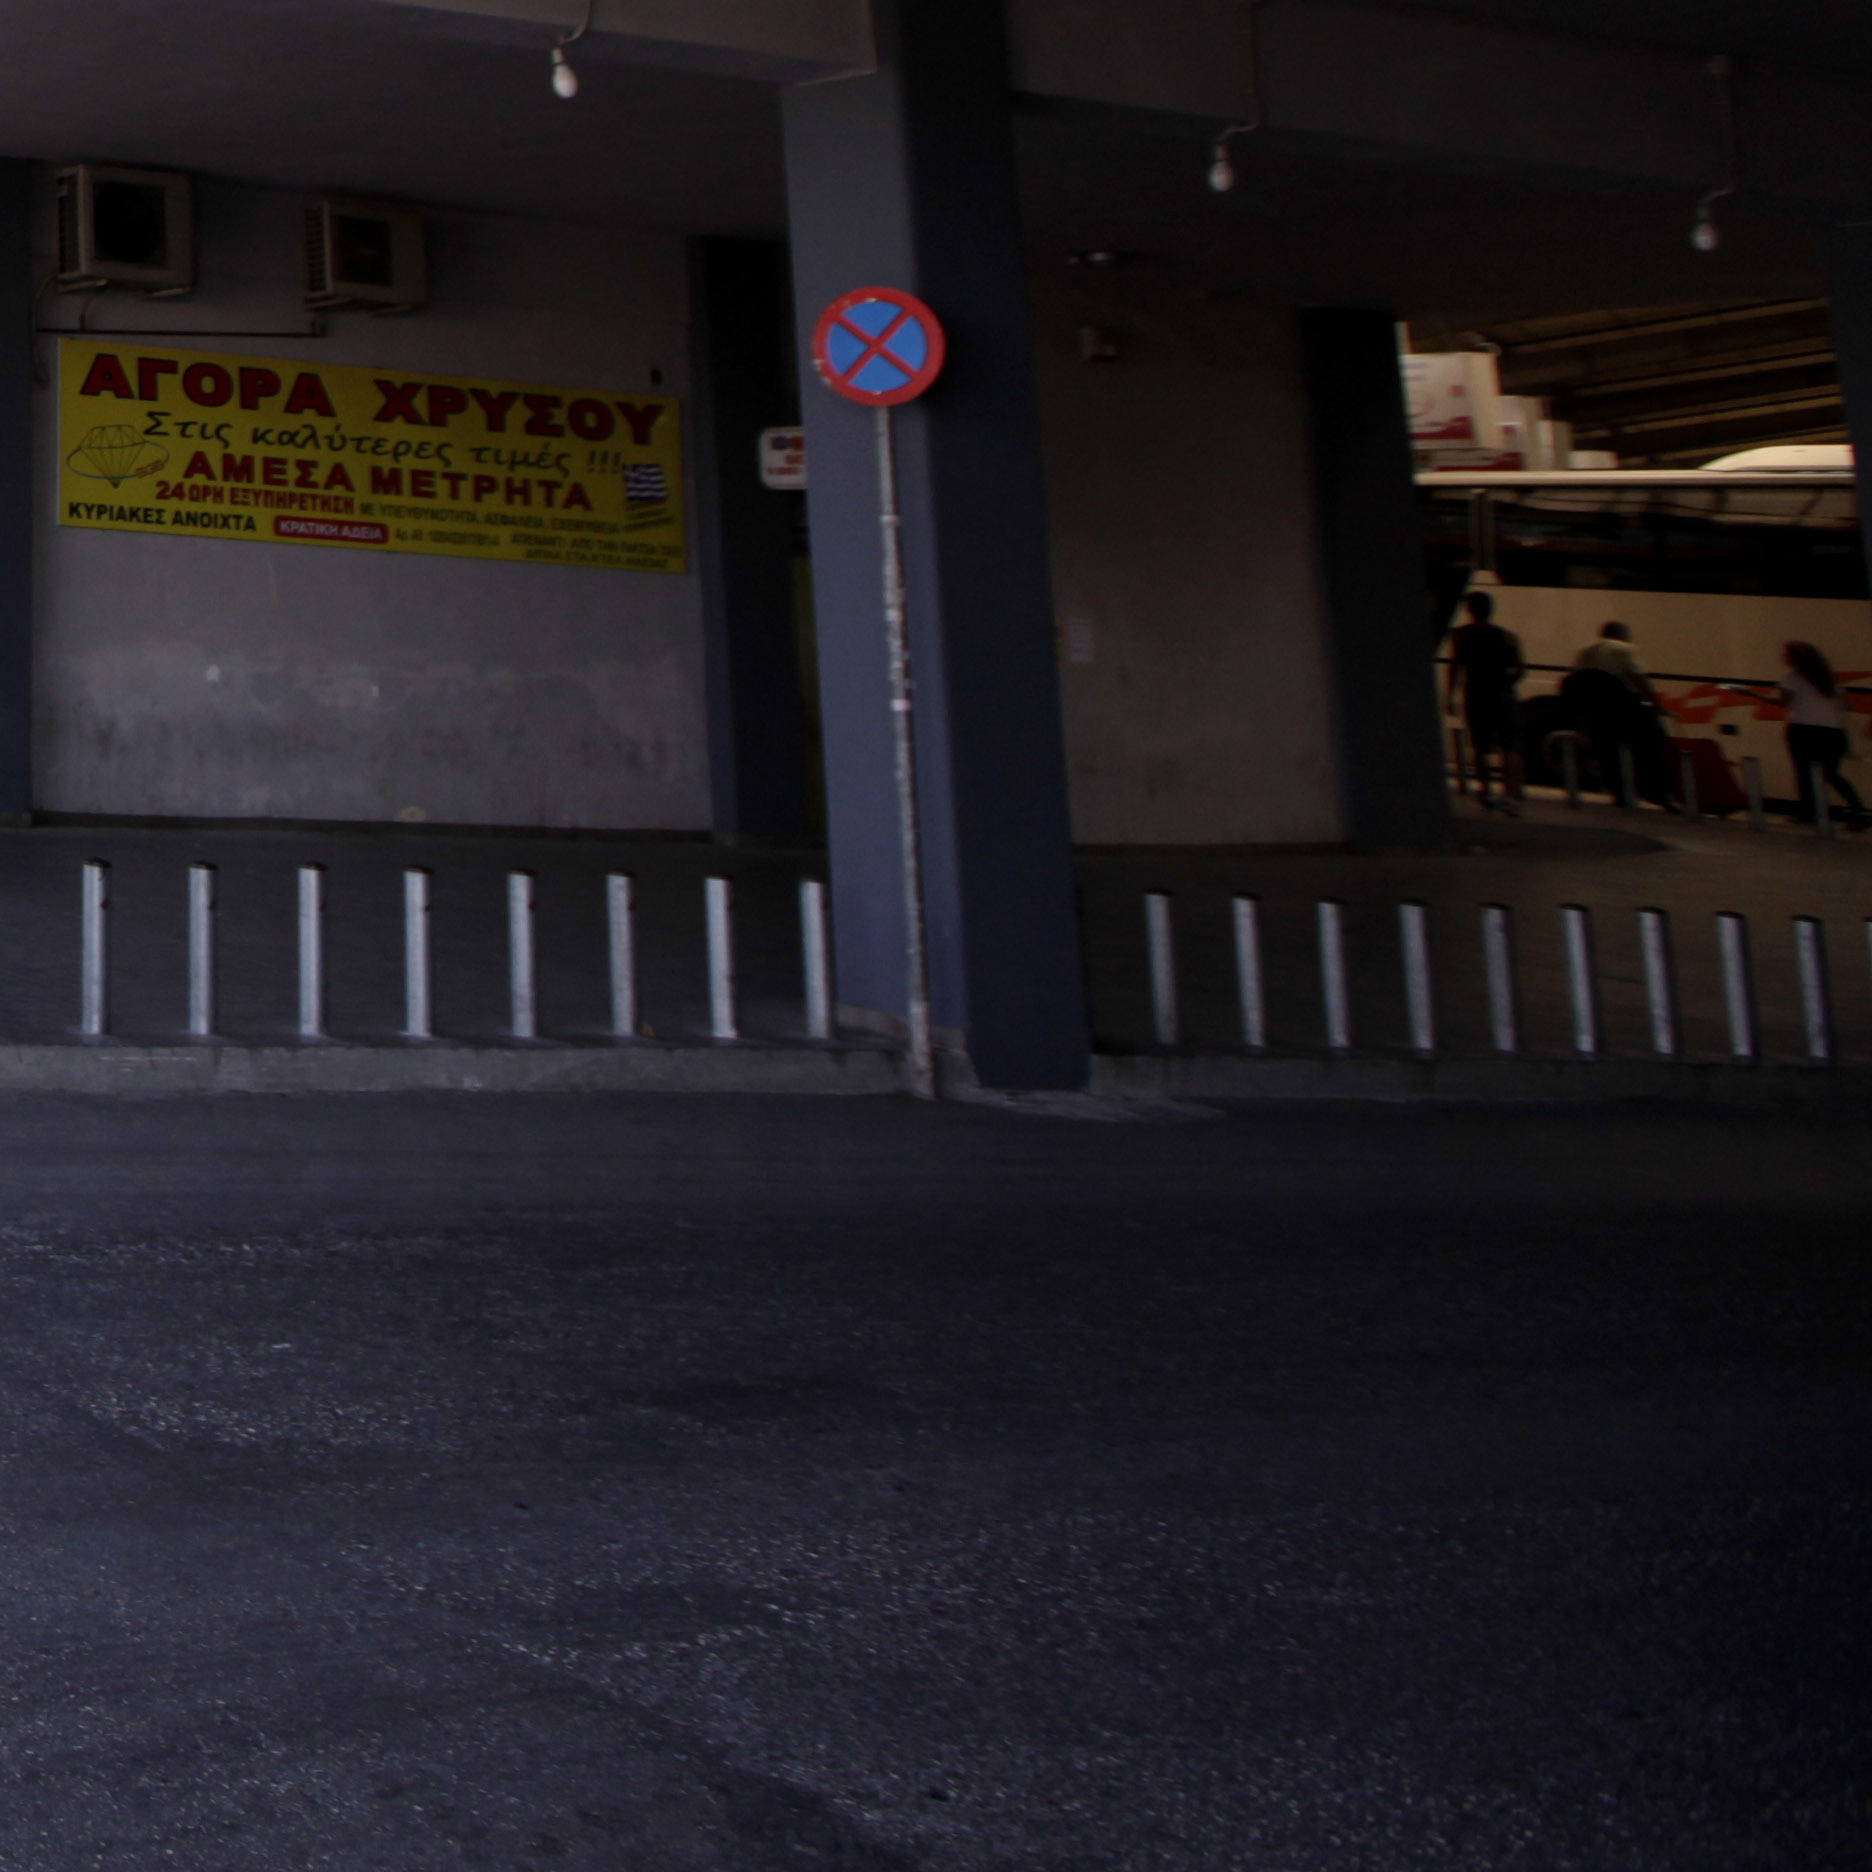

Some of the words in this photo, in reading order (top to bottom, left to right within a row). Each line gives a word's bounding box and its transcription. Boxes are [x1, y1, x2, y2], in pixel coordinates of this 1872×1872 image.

[80, 352, 337, 418] ΑΓΟΡΑ
[373, 377, 667, 446] ΧΡΥΣΟΥ
[144, 411, 232, 448] Στις
[252, 422, 453, 466] καλύτερες
[471, 442, 572, 475] τιμές
[183, 451, 355, 491] ΑΜΕΣΑ
[371, 466, 594, 512] ΜΕΤΡΗΤΑ
[229, 487, 355, 514] ΕΞΥΠΗΡΕΤΗΣΗ
[68, 501, 166, 525] ΚΥΡΙΑΚΕΣ
[171, 509, 257, 532] ΑΝΟΙΧΤΑ
